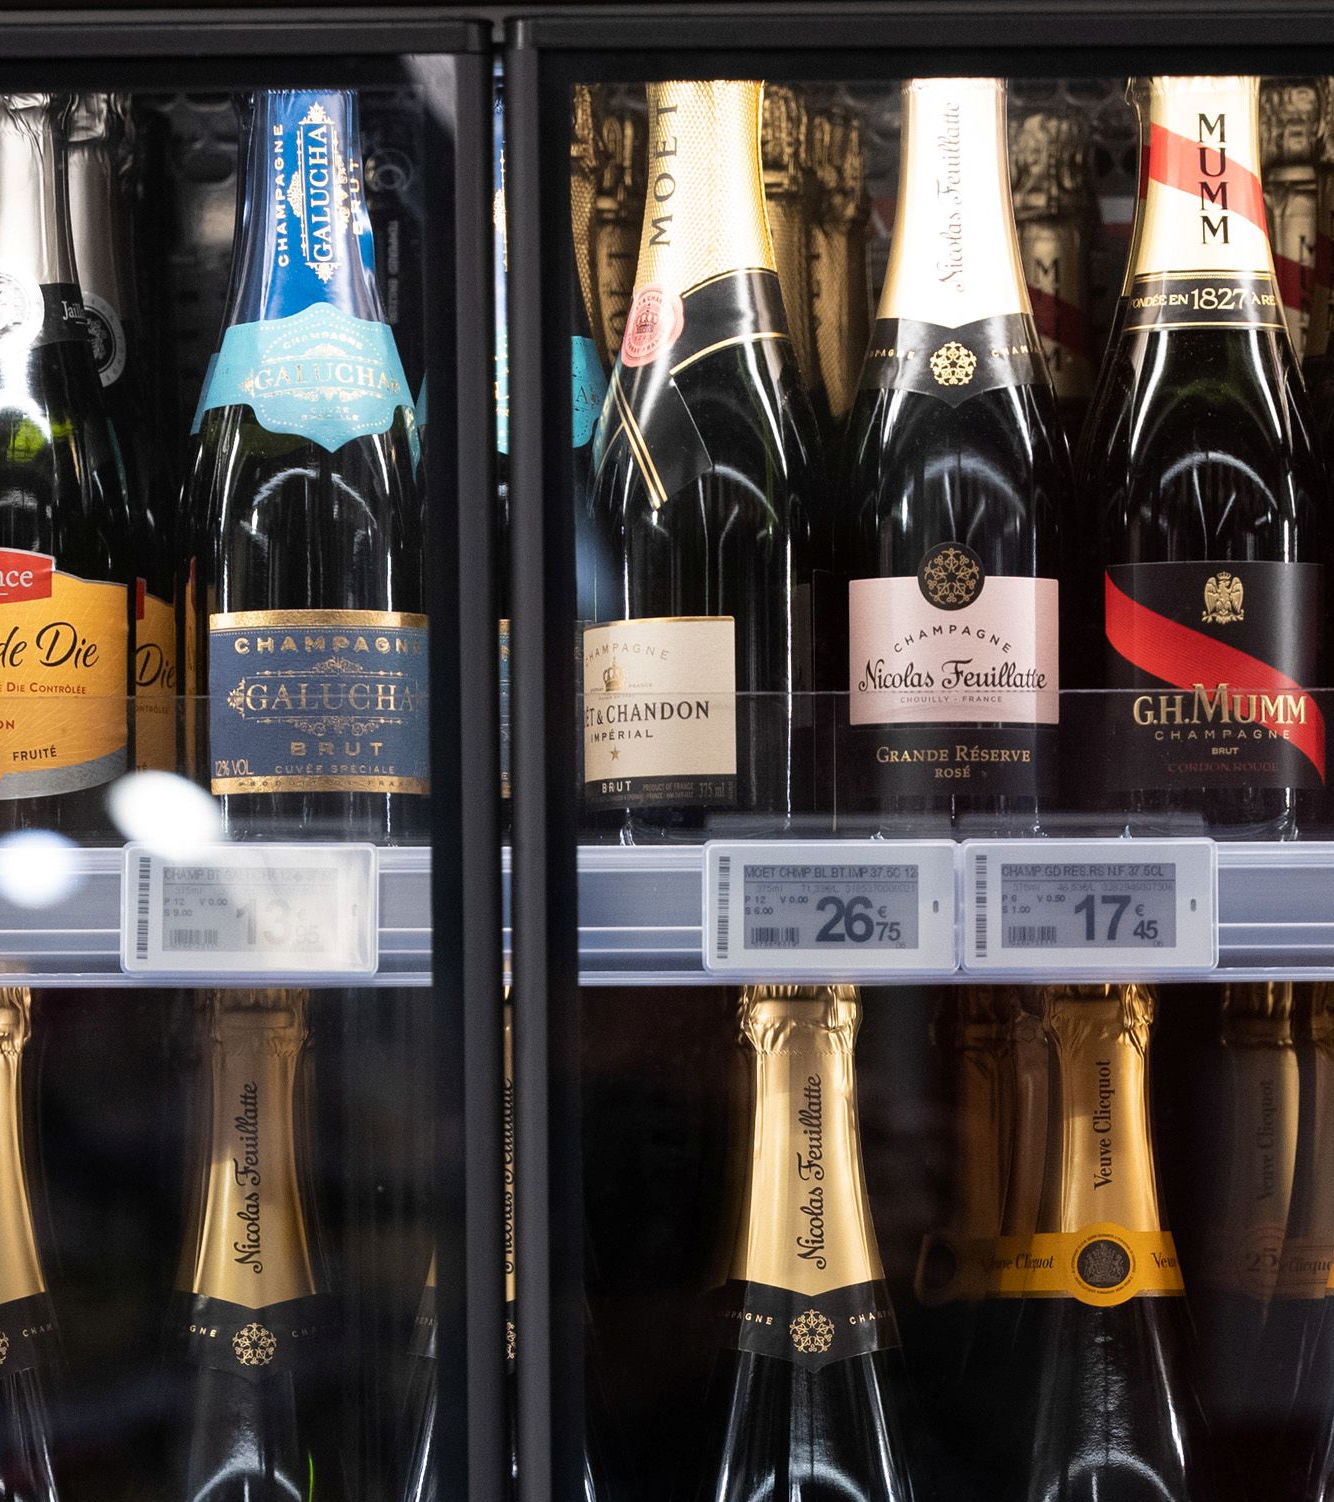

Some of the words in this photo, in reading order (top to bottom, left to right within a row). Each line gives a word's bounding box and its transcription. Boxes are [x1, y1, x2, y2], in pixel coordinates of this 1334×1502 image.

[310, 124, 334, 262] GALUCHA
[1197, 113, 1230, 244] MUMM
[274, 124, 289, 267] CHAMPAGNE
[1191, 289, 1249, 309] 1827
[255, 363, 391, 388] GALUCHA
[35, 622, 98, 667] Die
[858, 662, 934, 693] Nicolas
[941, 659, 1048, 691] Feuillatte
[246, 683, 413, 712] GALUCHA
[606, 701, 709, 723] CHANDON
[900, 696, 950, 704] CHOUILLY
[291, 742, 384, 756] BRUT
[1155, 730, 1290, 740] CHAMPAGNE
[13, 745, 57, 761] FRUITÉ
[876, 747, 949, 763] GRANDE
[955, 744, 1031, 763] RÉSERVE
[1212, 747, 1238, 755] BRUT
[331, 764, 395, 774] SPÉCIALE
[934, 766, 971, 779] ROSÉ
[602, 781, 631, 794] BRUT
[815, 895, 873, 943] 26
[876, 922, 901, 941] 75
[1073, 895, 1131, 941] 17
[1133, 920, 1158, 940] 45
[1093, 1059, 1116, 1130] Clicquot
[235, 1080, 261, 1187] Feuillatte
[1094, 1133, 1111, 1190] Veuve
[234, 1192, 263, 1274] Nicolas
[797, 1188, 826, 1271] Nicolas
